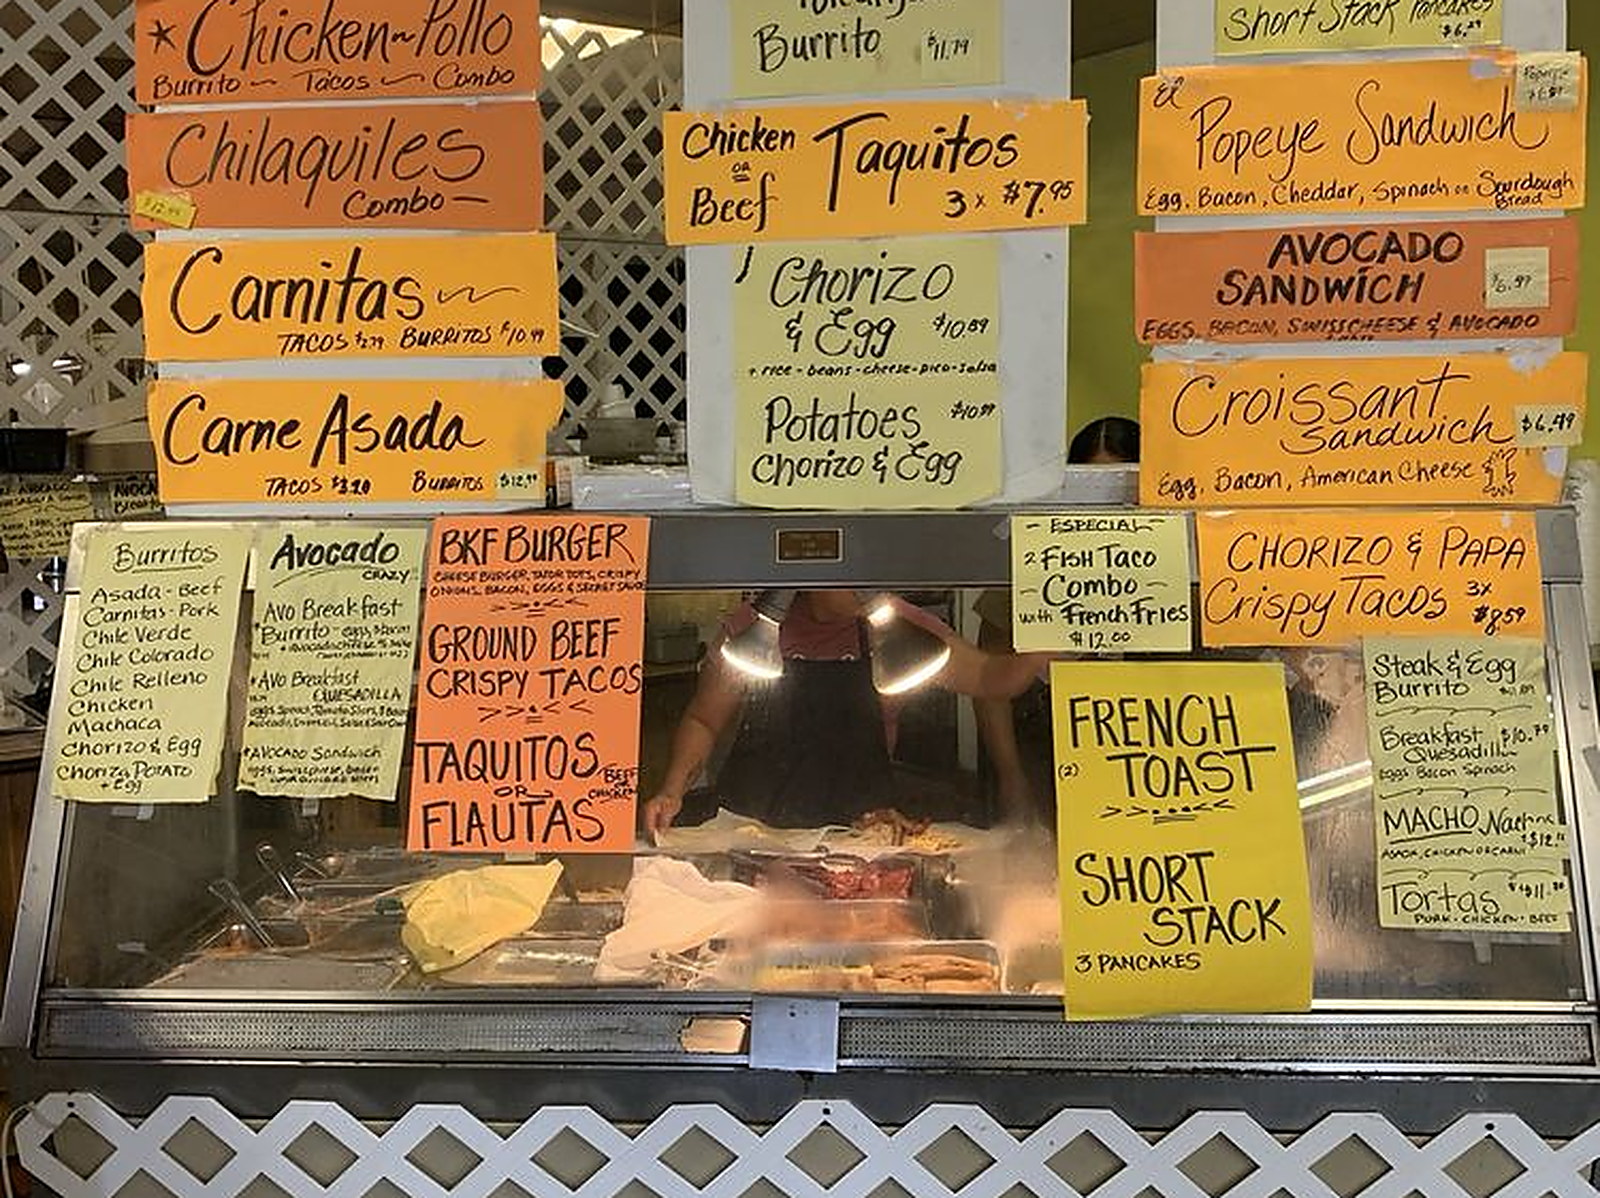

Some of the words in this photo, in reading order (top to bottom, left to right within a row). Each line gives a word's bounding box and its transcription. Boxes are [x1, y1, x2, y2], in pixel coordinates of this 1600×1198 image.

[1223, 1, 1316, 41] Short
[1318, 0, 1398, 33] Stack
[187, 0, 389, 76] Chicken
[752, 16, 881, 72] Burrito
[153, 74, 242, 99] Burrito
[293, 68, 370, 92] Tacos
[433, 62, 514, 90] Combo
[682, 116, 795, 158] Chicken
[1190, 96, 1326, 181] Popeye
[1347, 80, 1549, 165] Sandwich
[165, 116, 485, 208] Chilaquiles
[812, 112, 1019, 211] Taquitos
[944, 190, 966, 218] 3
[1002, 179, 1075, 218] $7.95
[1476, 170, 1574, 198] Sourdough
[1495, 191, 1543, 209] Bread
[343, 190, 444, 220] Combo
[690, 172, 779, 233] Beef
[1268, 230, 1464, 269] AVOCADO
[169, 246, 425, 334] Carnitas
[769, 251, 955, 307] Chorizo
[277, 333, 348, 355] TACOS
[400, 326, 491, 349] BURRITOS
[785, 311, 803, 352] &
[815, 307, 897, 358] Egg
[1426, 312, 1442, 339] &
[1449, 314, 1540, 332] AVOCADO
[1172, 362, 1471, 437] Croissant
[162, 394, 303, 466] Carne
[311, 394, 486, 467] Asada
[765, 392, 921, 443] Potatoes
[751, 449, 865, 486] Chorizo
[872, 446, 888, 483] &
[895, 441, 963, 485] Egg
[1302, 460, 1394, 488] American
[1399, 459, 1473, 481] Cheese
[266, 477, 323, 496] TACOS
[412, 470, 484, 492] BURRITOS
[1051, 518, 1145, 533] ESPECIAL
[113, 541, 219, 572] Burritos
[270, 531, 400, 570] Avocado
[439, 527, 499, 565] BKF
[504, 522, 636, 564] BURGER
[1040, 545, 1094, 570] FISH
[1097, 543, 1157, 568] Taco
[1227, 531, 1392, 572] CHORIZO
[1406, 529, 1423, 571] &
[1440, 526, 1526, 570] PAPA
[91, 584, 161, 604] Asada
[178, 575, 224, 598] Beef
[362, 569, 411, 584] CRAZY
[1042, 573, 1138, 606] Combo
[83, 605, 166, 627] Carnitas
[178, 602, 220, 617] Pork
[302, 594, 404, 620] Breakfast
[1019, 608, 1053, 624] with
[1060, 602, 1128, 626] French
[1129, 597, 1189, 625] Fries
[1204, 577, 1336, 637] Crispy
[1340, 575, 1447, 619] Tacos
[82, 626, 130, 649] Chile
[134, 626, 192, 643] Verde
[261, 620, 331, 646] Burrito
[428, 624, 537, 664] GROUND
[551, 618, 621, 661] BEEF
[76, 651, 123, 673] Chile
[128, 644, 215, 665] Colorado
[1373, 650, 1443, 679] Steak
[1447, 650, 1461, 679] &
[1465, 650, 1517, 684] Egg
[70, 676, 123, 698] Chile
[133, 671, 208, 689] Relleno
[291, 666, 359, 688] Breakfast
[426, 668, 530, 699] CRISPY
[539, 664, 642, 699] TACOS
[1375, 679, 1470, 704] Burrito
[67, 697, 153, 717] Chicken
[1069, 694, 1240, 748] FRENCH
[67, 717, 163, 737] Machaca
[1380, 721, 1483, 751] Breakfast
[60, 738, 147, 758] Chorizo
[167, 735, 203, 758] Egg
[1106, 746, 1276, 798] TOAST
[422, 798, 605, 849] FLAUTAS
[1383, 804, 1479, 836] MACHO
[1075, 851, 1214, 906] SHORT
[1382, 881, 1500, 915] Tortas
[1143, 898, 1287, 947] STACK
[1074, 955, 1092, 973] 3
[1099, 952, 1202, 974] PANCAKES
